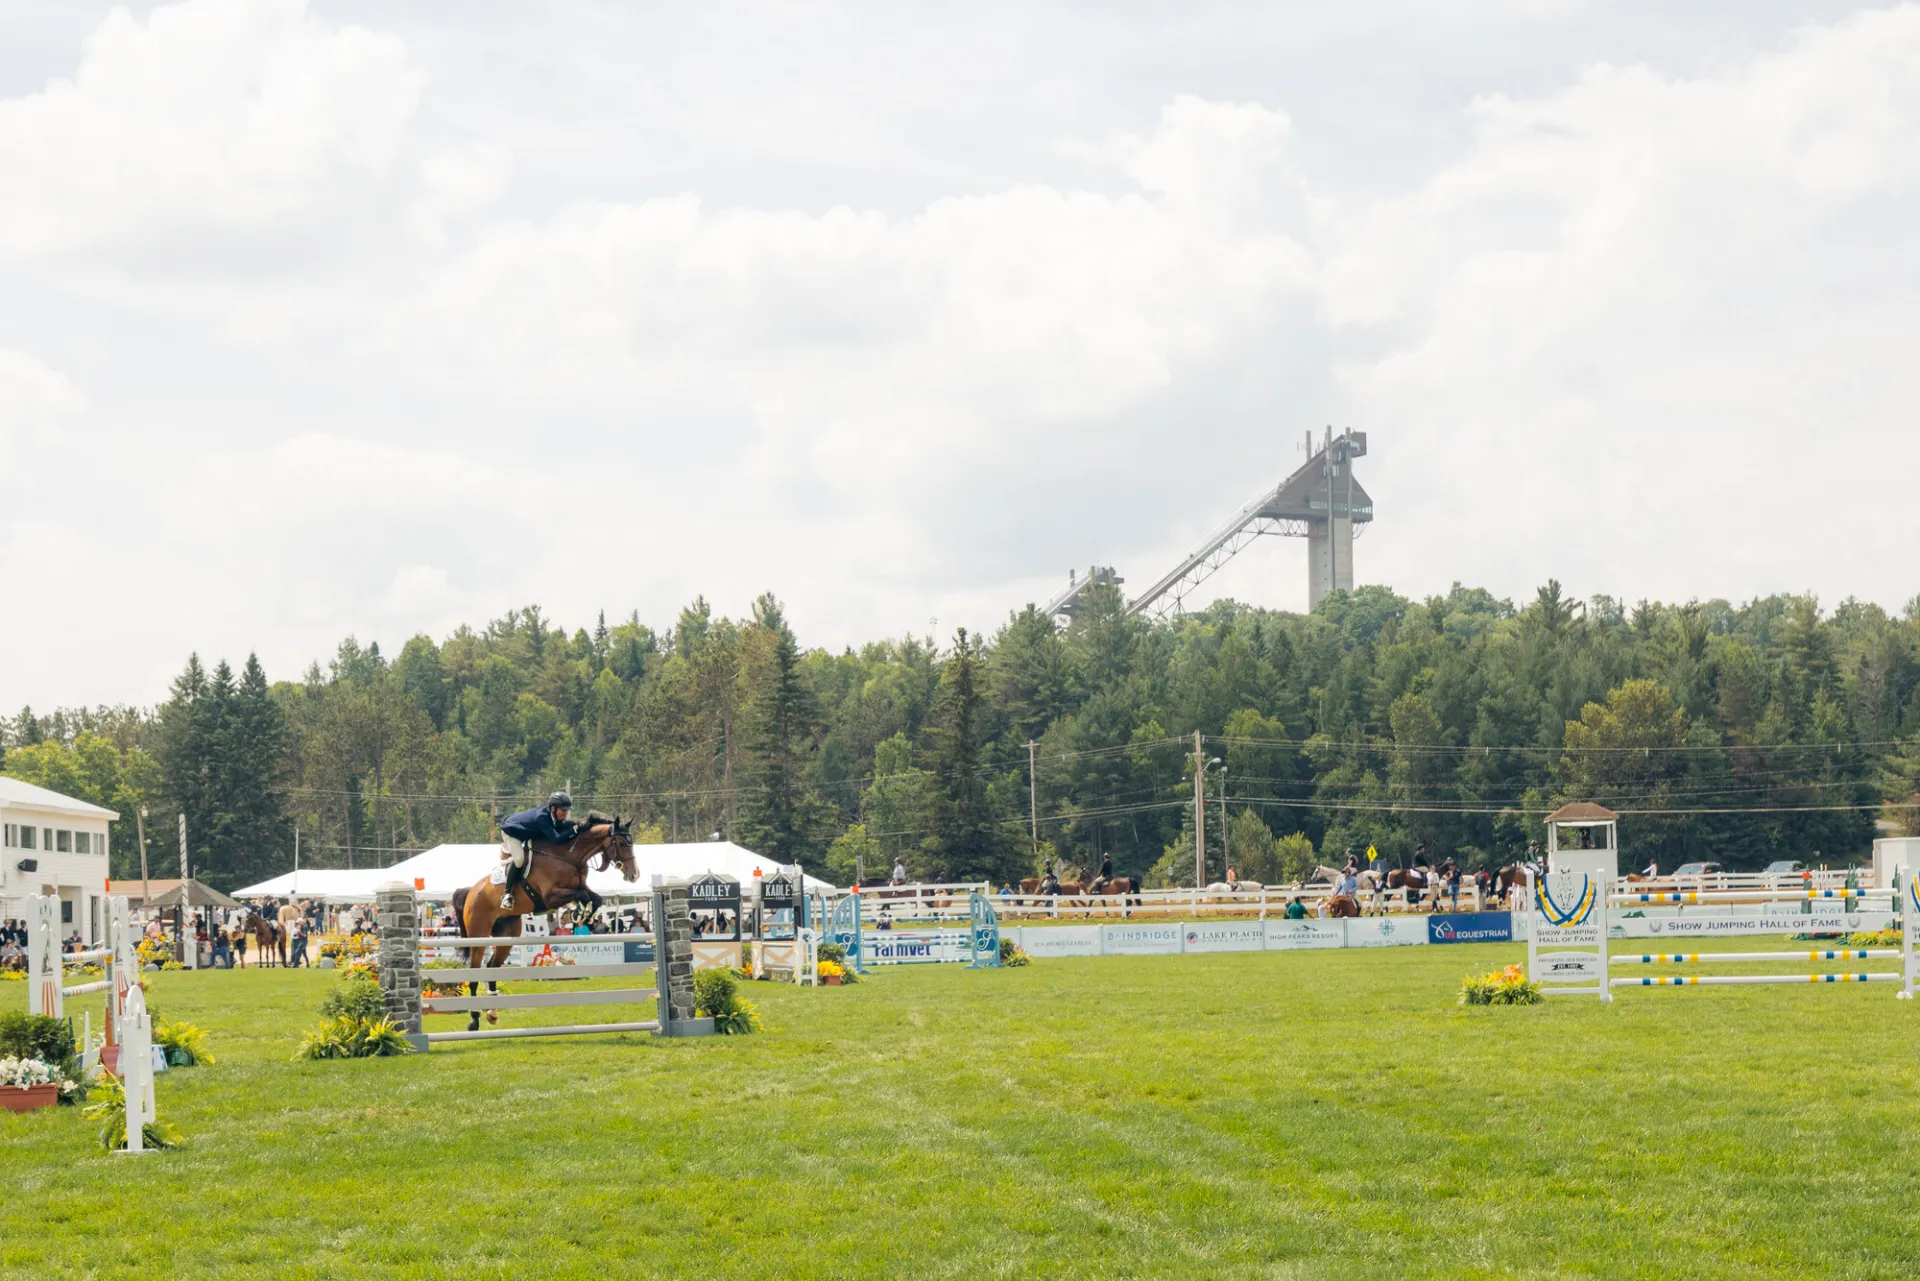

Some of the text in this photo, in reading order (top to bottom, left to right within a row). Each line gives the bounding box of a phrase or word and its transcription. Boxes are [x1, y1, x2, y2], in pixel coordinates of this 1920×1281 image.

[692, 884, 731, 897] KADLEY
[765, 884, 793, 897] KADLE
[1668, 918, 1842, 931] SHOW JUMPING HALL OF FAME
[1108, 931, 1177, 940] BAINBRIDGE
[1230, 930, 1263, 938] PLACID
[1457, 929, 1508, 939] EQUESTRIAN
